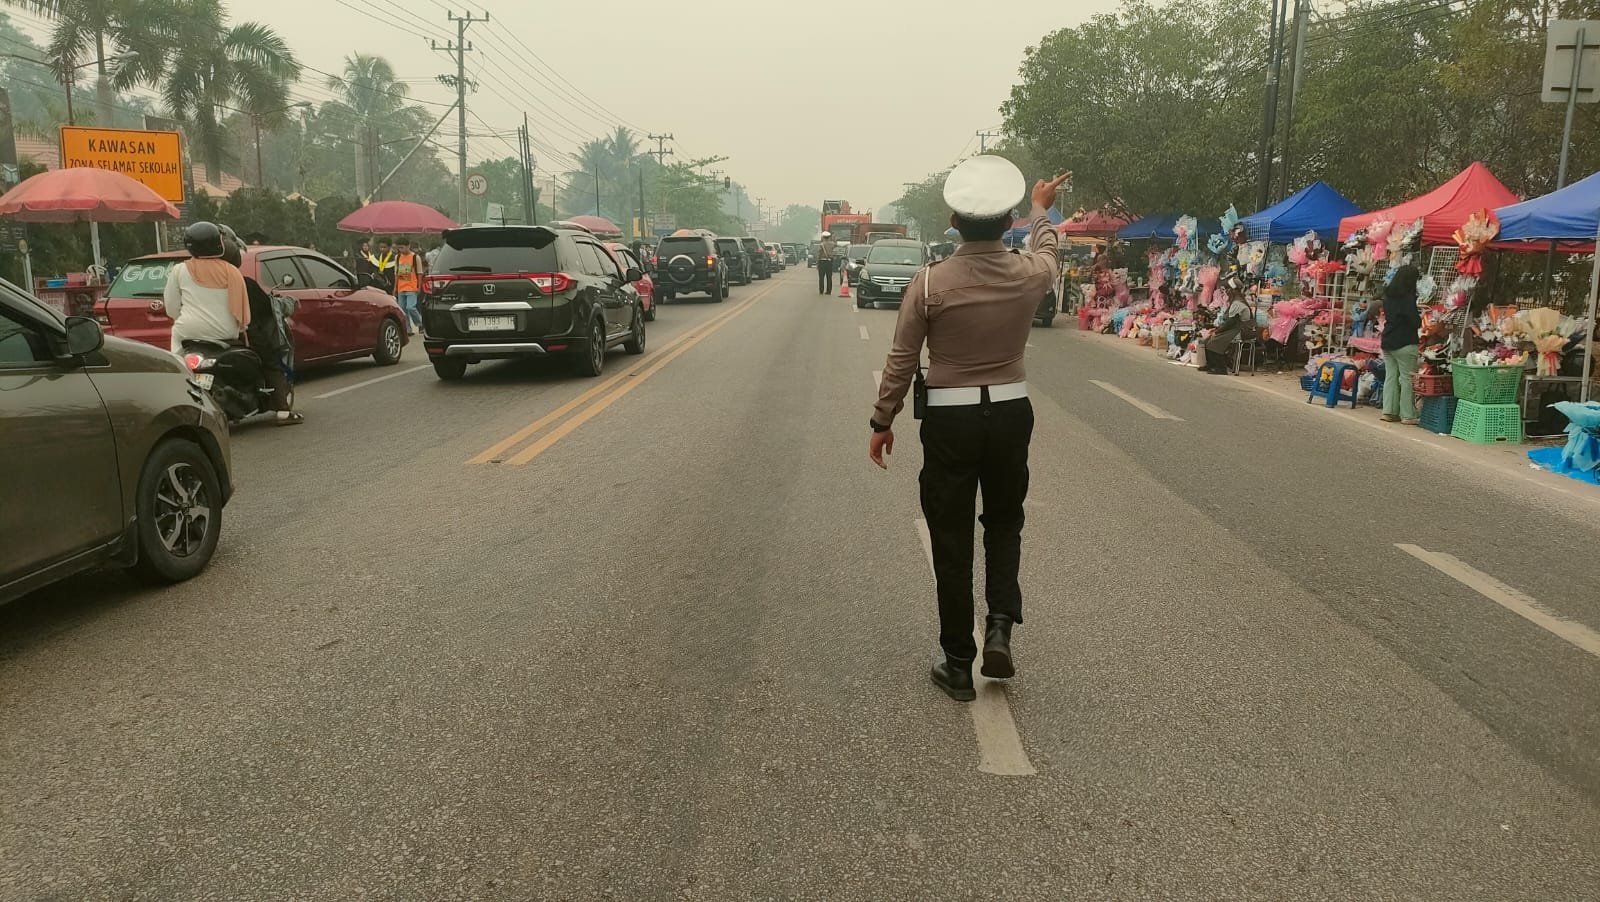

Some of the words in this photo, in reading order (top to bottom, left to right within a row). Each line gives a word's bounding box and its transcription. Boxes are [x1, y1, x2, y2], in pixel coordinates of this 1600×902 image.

[88, 138, 156, 154] KAWASAN
[97, 159, 137, 174] SELAMAT
[139, 161, 177, 175] SEKOLAH
[470, 179, 480, 190] 30
